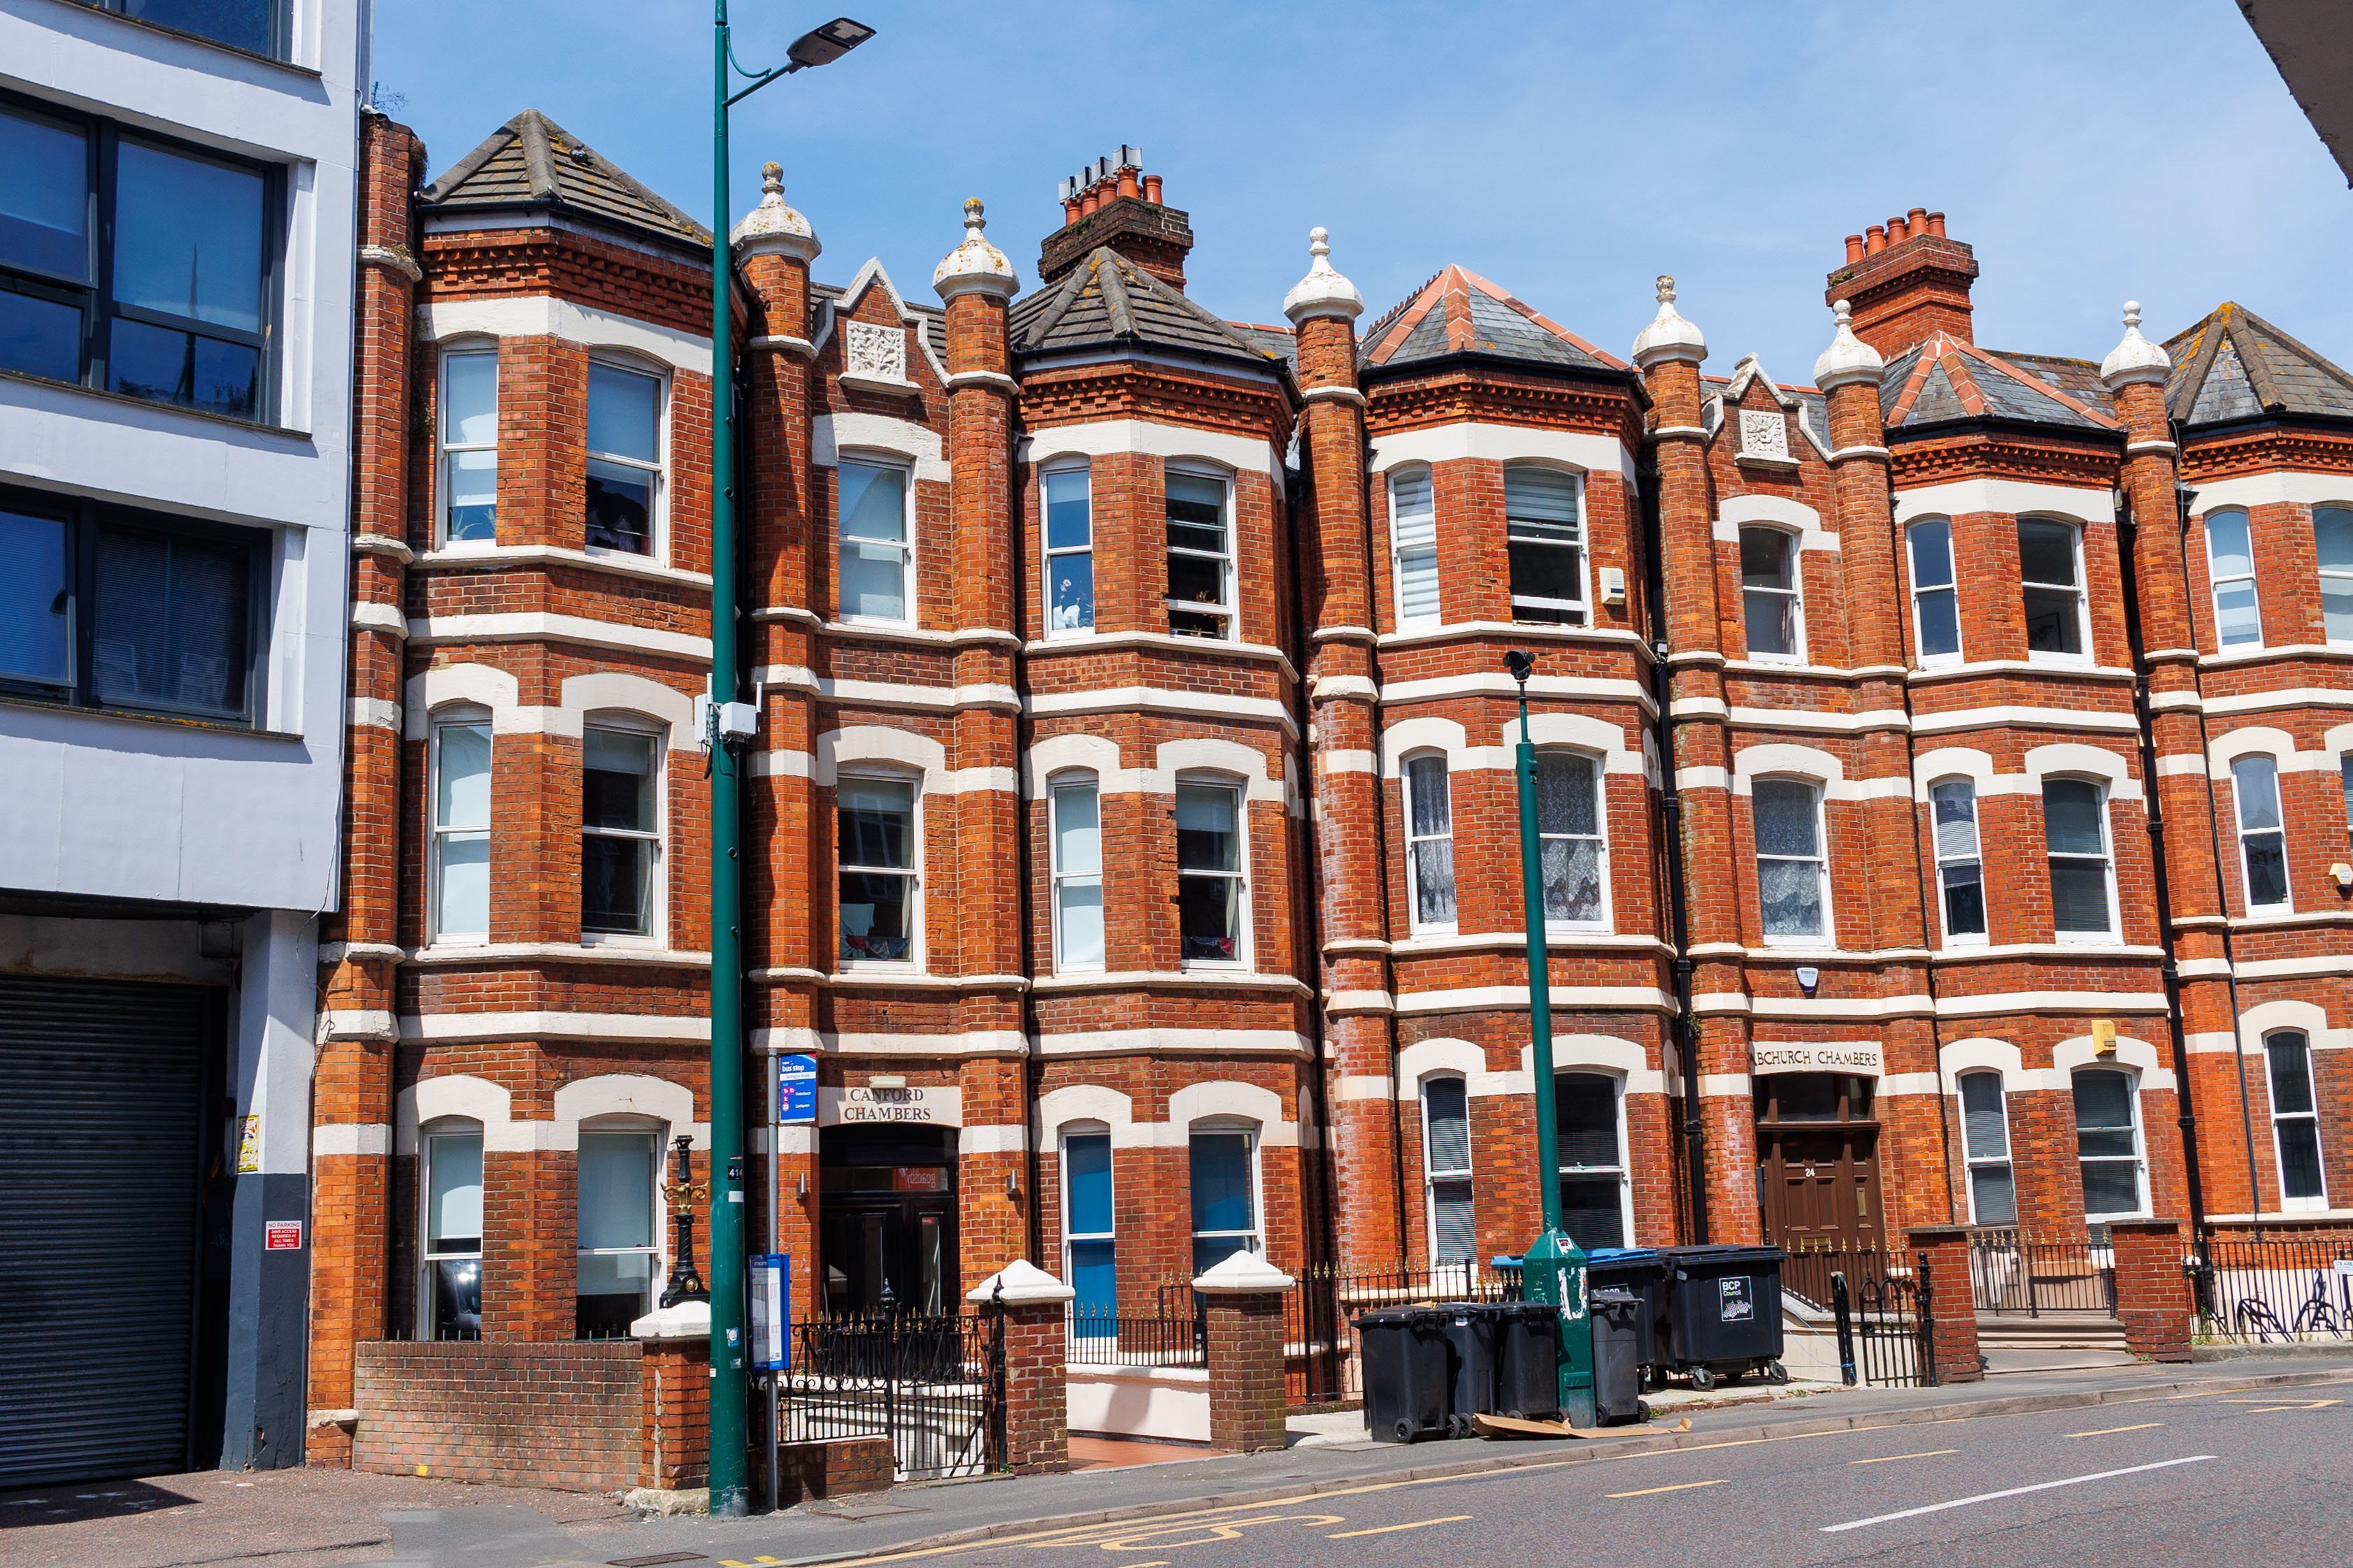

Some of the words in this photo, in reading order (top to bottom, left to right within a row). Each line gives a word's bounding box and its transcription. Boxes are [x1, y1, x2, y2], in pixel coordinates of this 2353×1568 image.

[1817, 1051, 1878, 1066] CHAMBERS
[850, 1088, 924, 1102] CANFORD
[844, 1107, 931, 1121] CHAMBERS
[1805, 1168, 1816, 1177] 24
[1722, 1281, 1740, 1290] BCP
